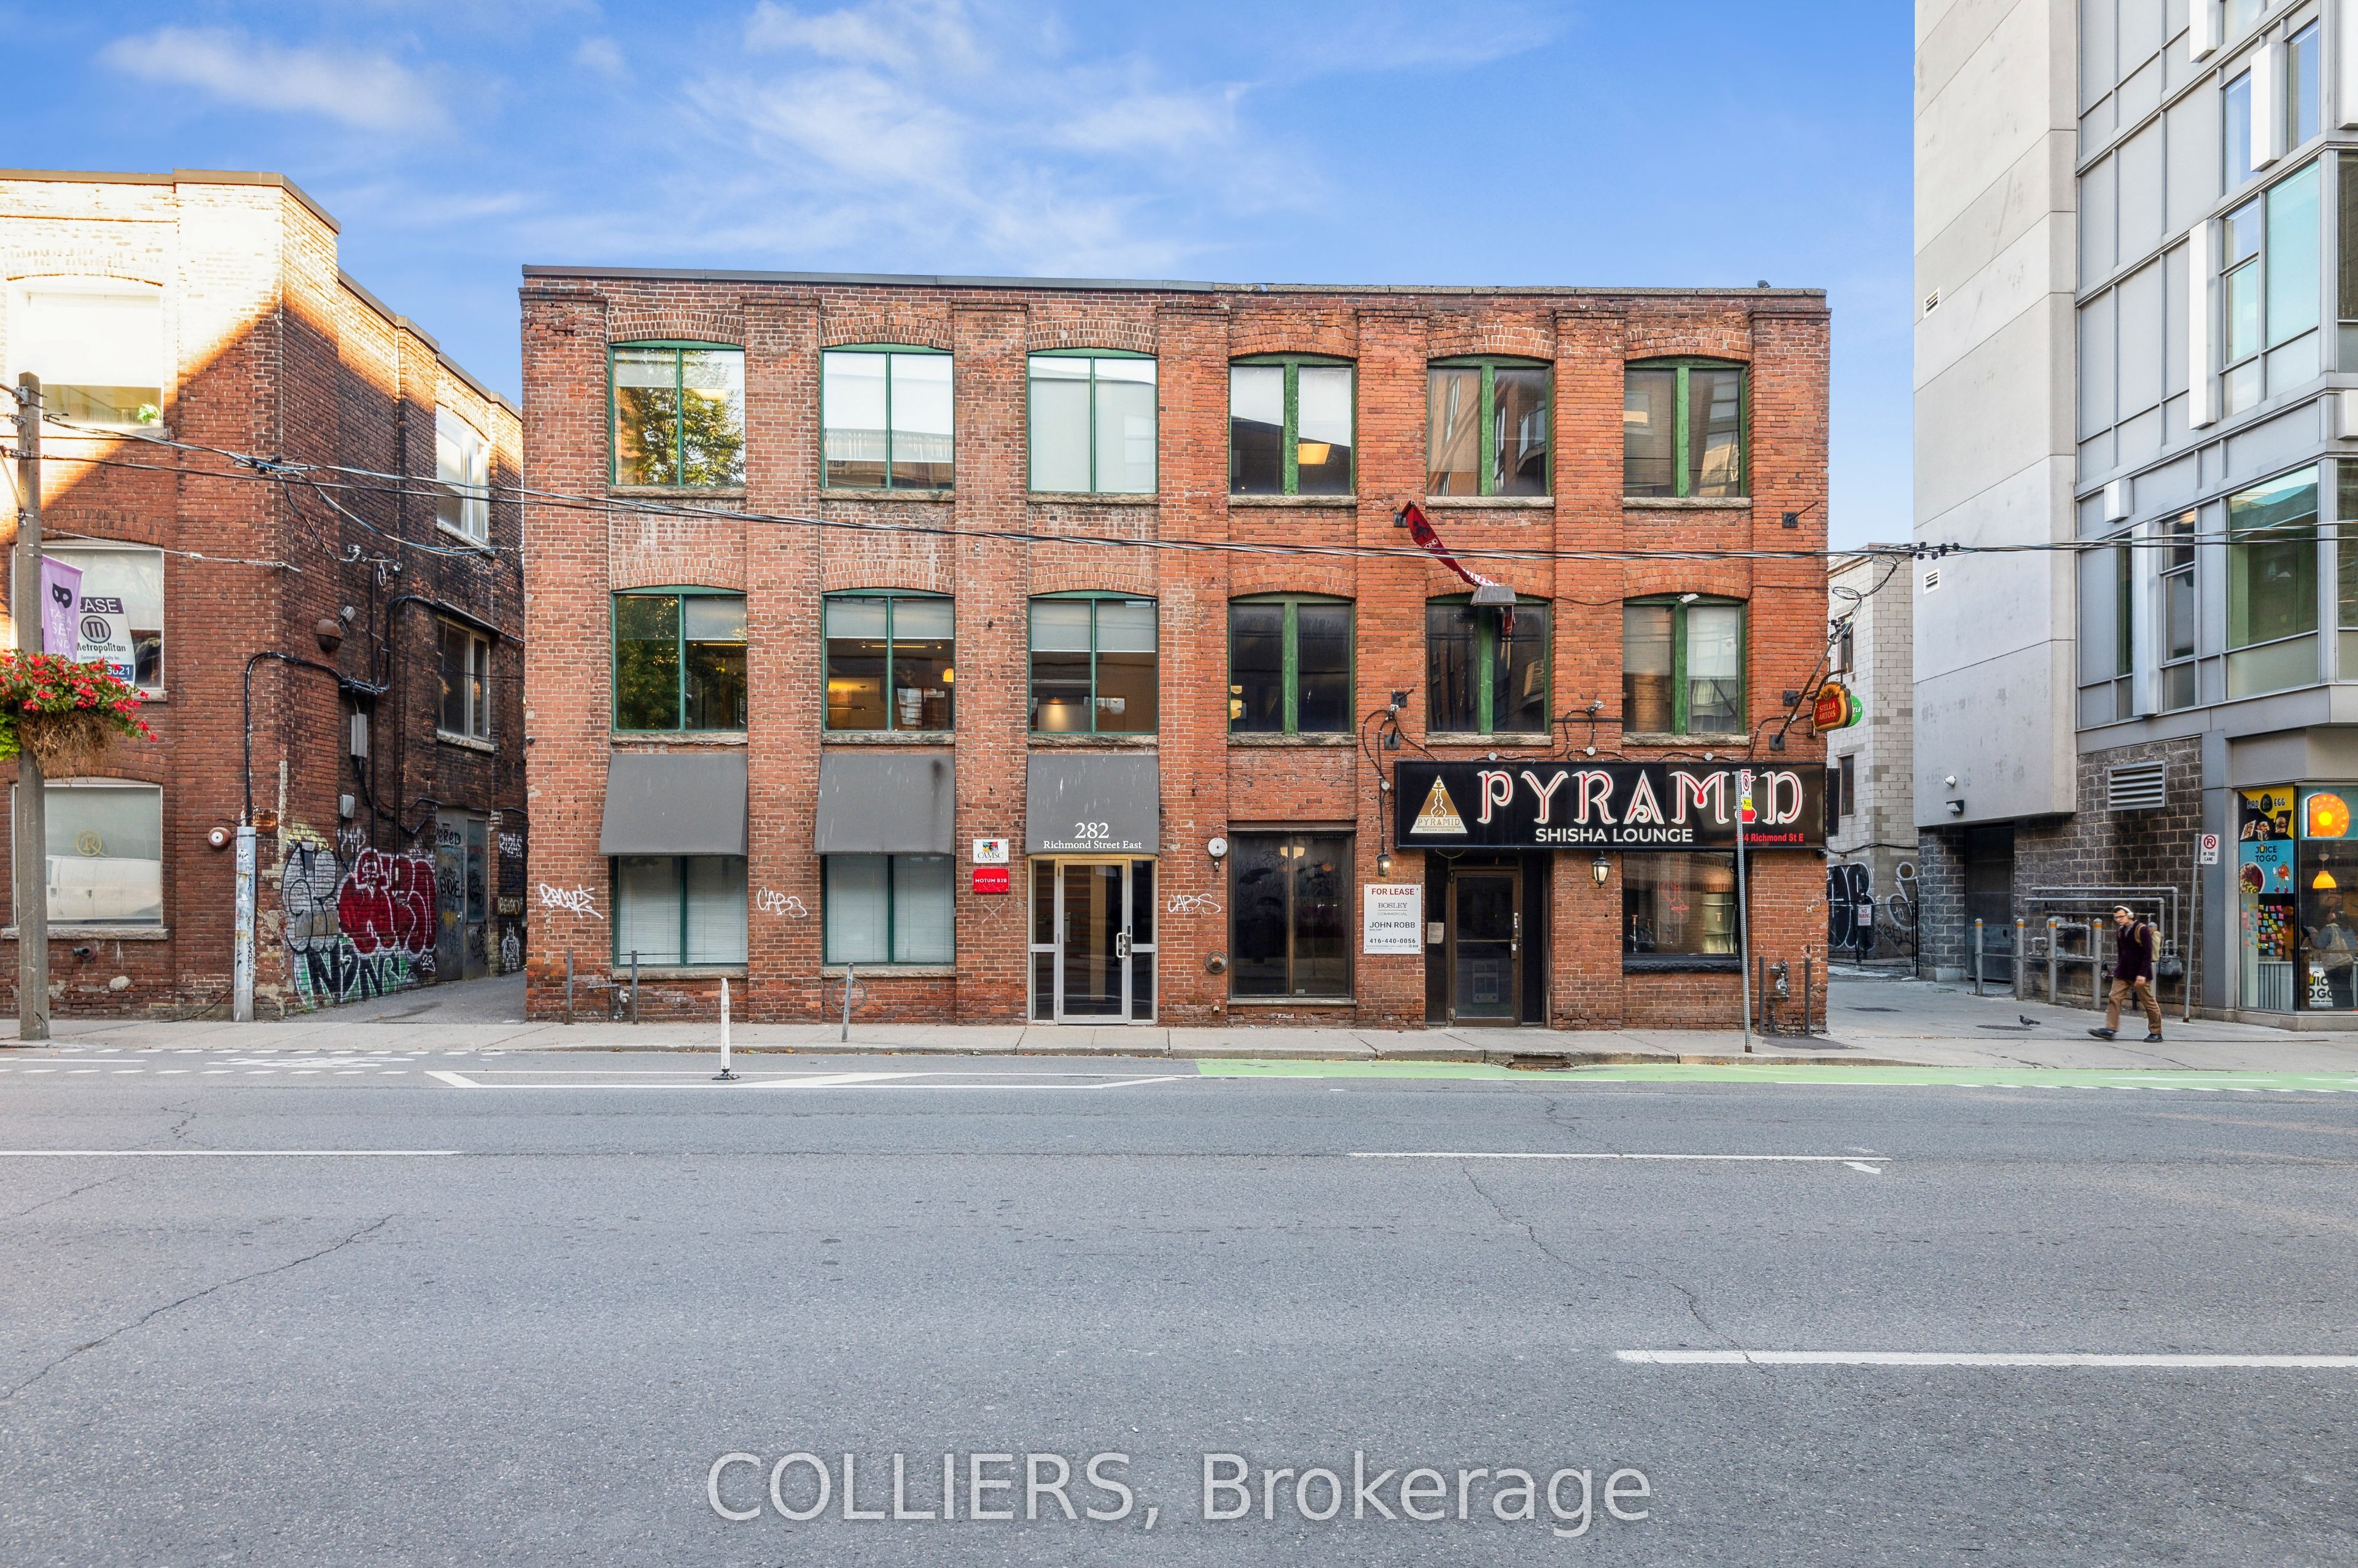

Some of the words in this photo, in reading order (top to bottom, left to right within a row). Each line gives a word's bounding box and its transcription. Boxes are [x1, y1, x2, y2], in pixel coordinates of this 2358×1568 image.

[80, 599, 119, 613] ASE
[1819, 702, 1835, 713] STELLA
[1819, 710, 1836, 721] ARTOIS
[2247, 800, 2259, 809] BAD
[2274, 798, 2285, 807] EGG
[1075, 822, 1110, 839] 282
[1535, 828, 1605, 842] SHISHA
[1613, 828, 1694, 842] LOUNGE
[1751, 833, 1787, 842] Richmond
[1788, 833, 1797, 842] St
[1043, 840, 1091, 849] Richmond
[1094, 840, 1121, 849] Street
[1123, 840, 1142, 849] East
